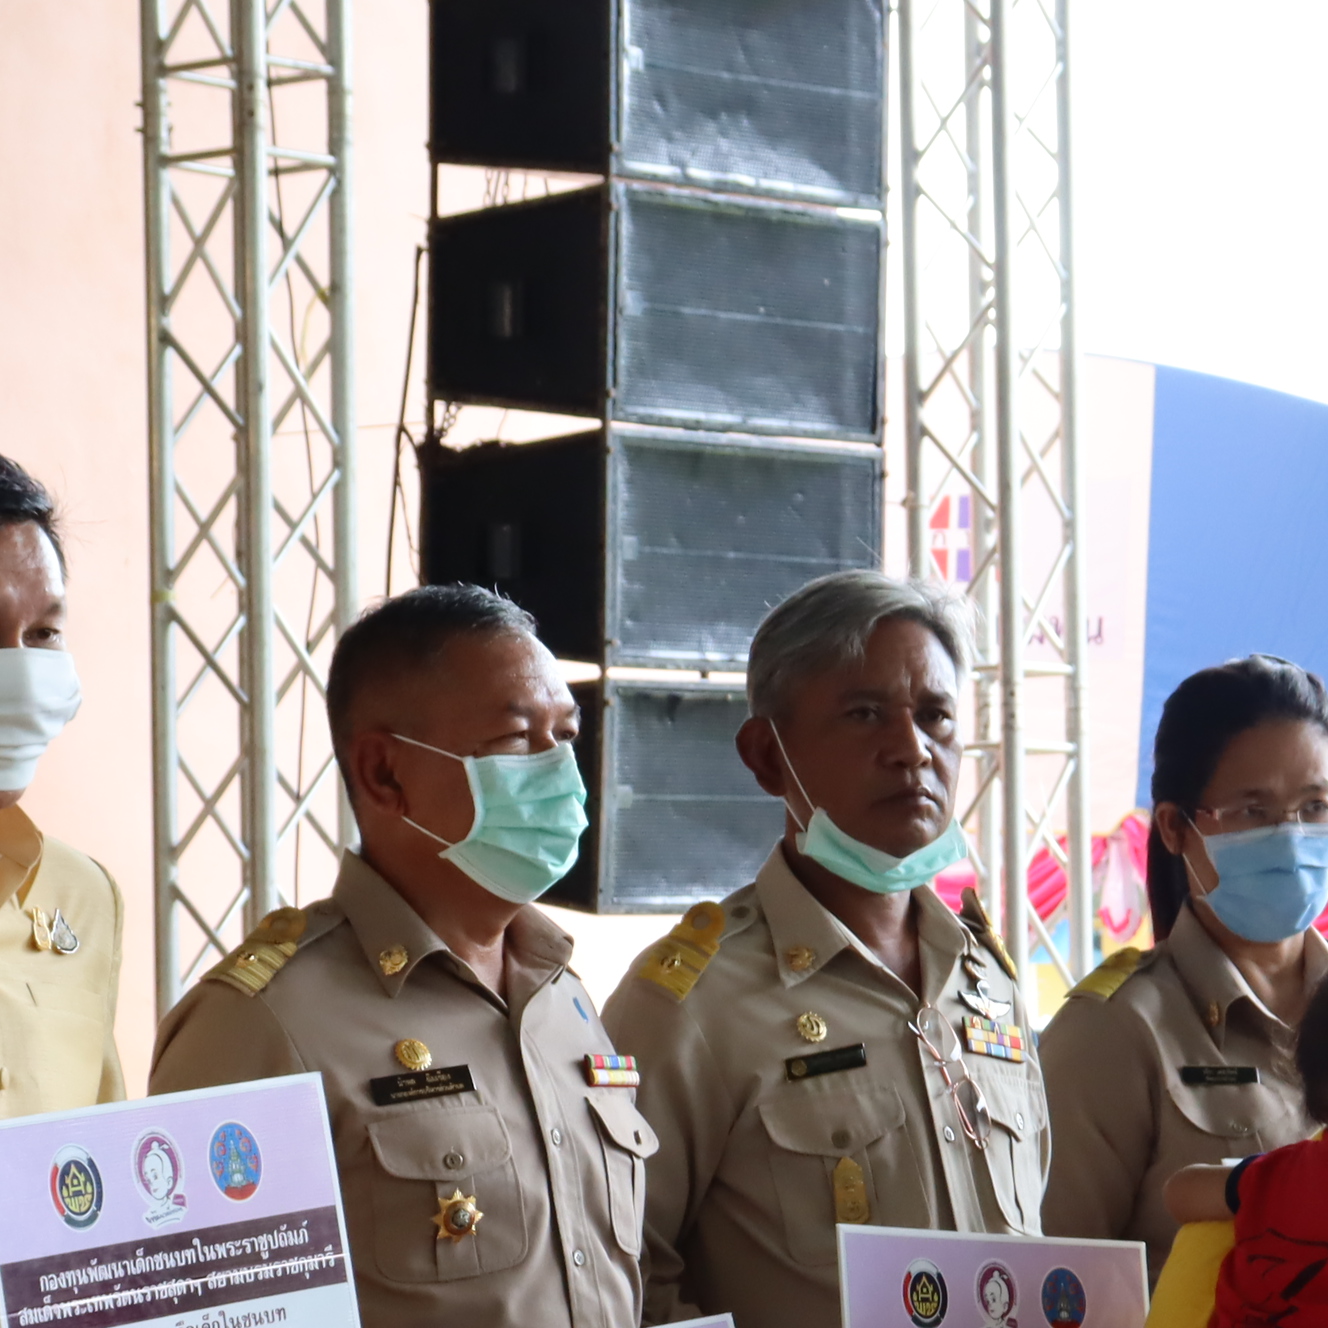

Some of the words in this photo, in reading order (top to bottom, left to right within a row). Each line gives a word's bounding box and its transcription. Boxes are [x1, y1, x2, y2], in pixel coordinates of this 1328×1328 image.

[39, 1220, 309, 1294] กองทุนพัฒนาเด็กชนบทในพระราชูปถัมภ์
